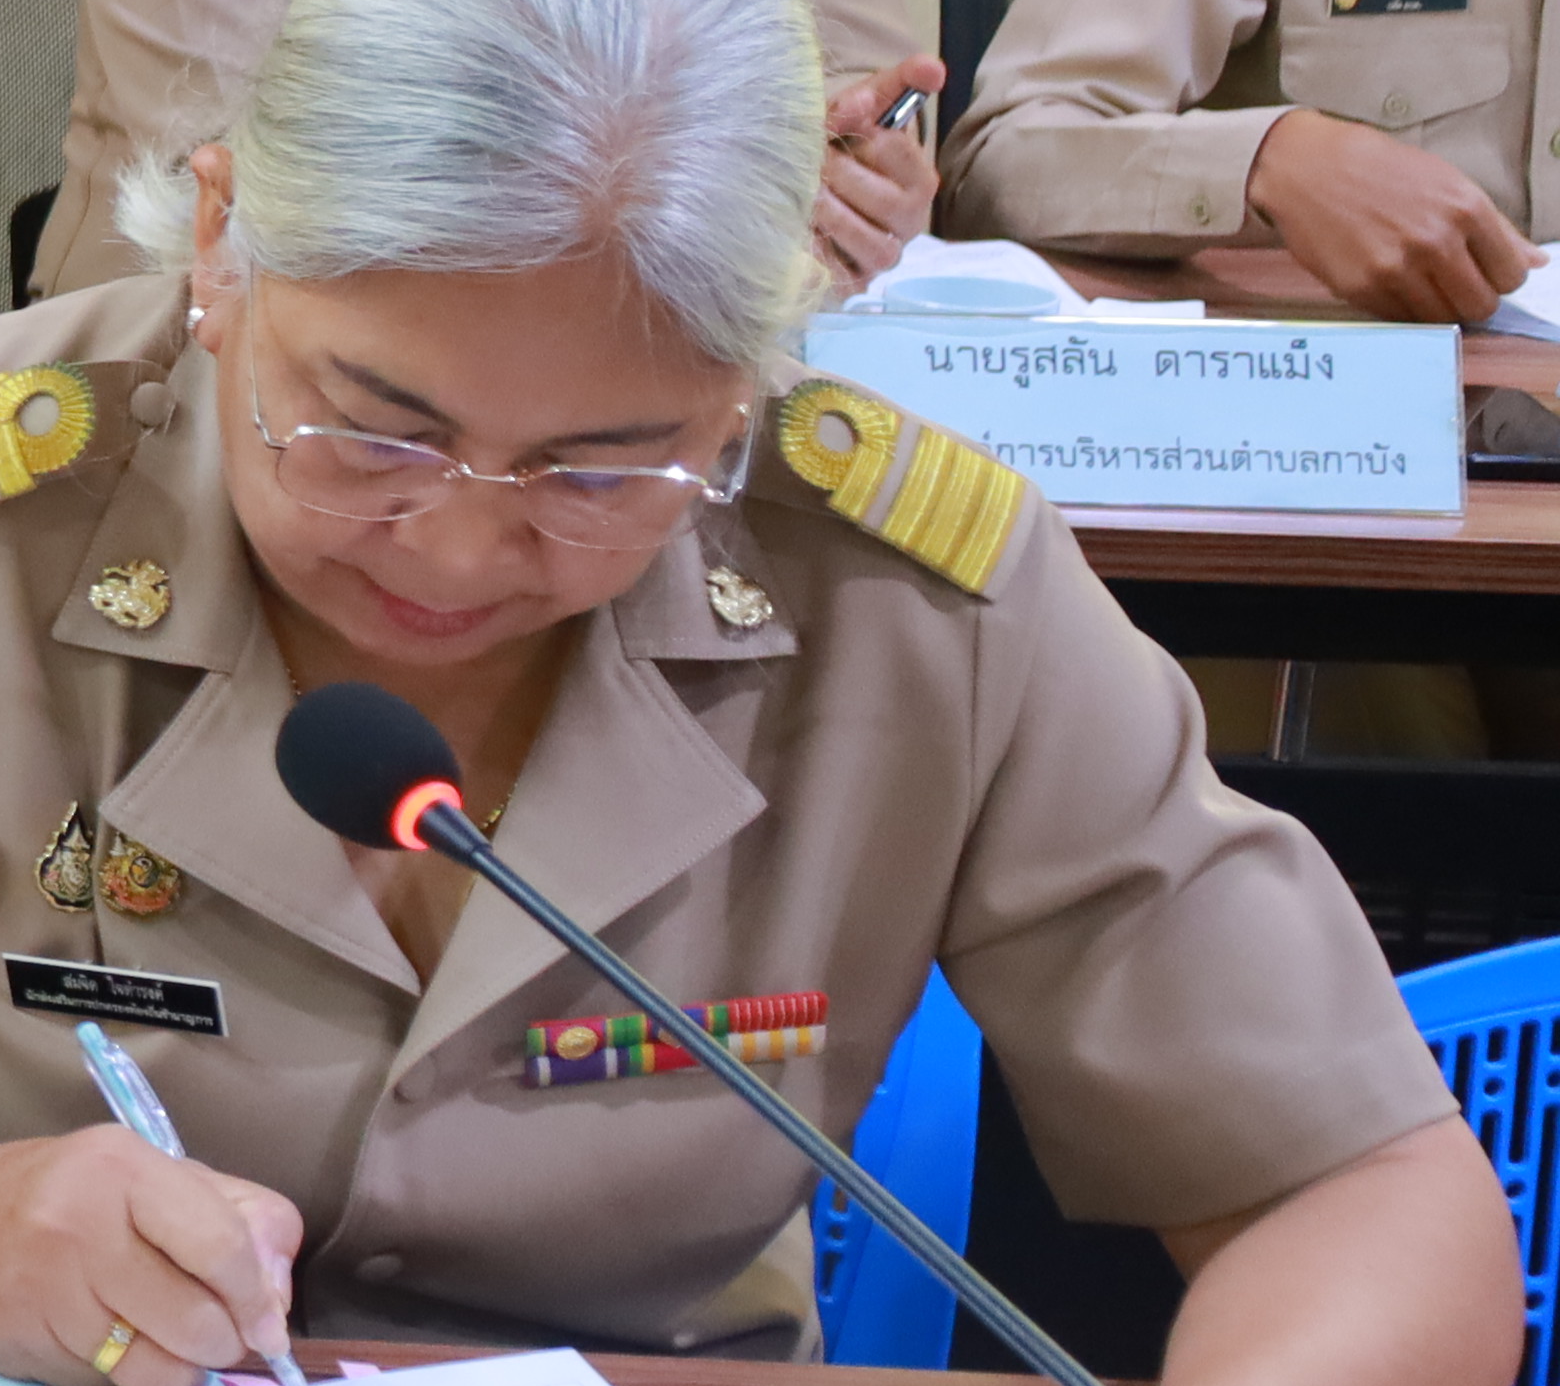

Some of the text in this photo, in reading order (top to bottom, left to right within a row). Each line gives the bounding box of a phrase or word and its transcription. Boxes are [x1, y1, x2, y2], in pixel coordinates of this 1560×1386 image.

[924, 337, 1335, 388] นายรูสลัน ดาราแม็ง
[981, 430, 1407, 477] ์การบริหารส่วนตำบลกาบัง
